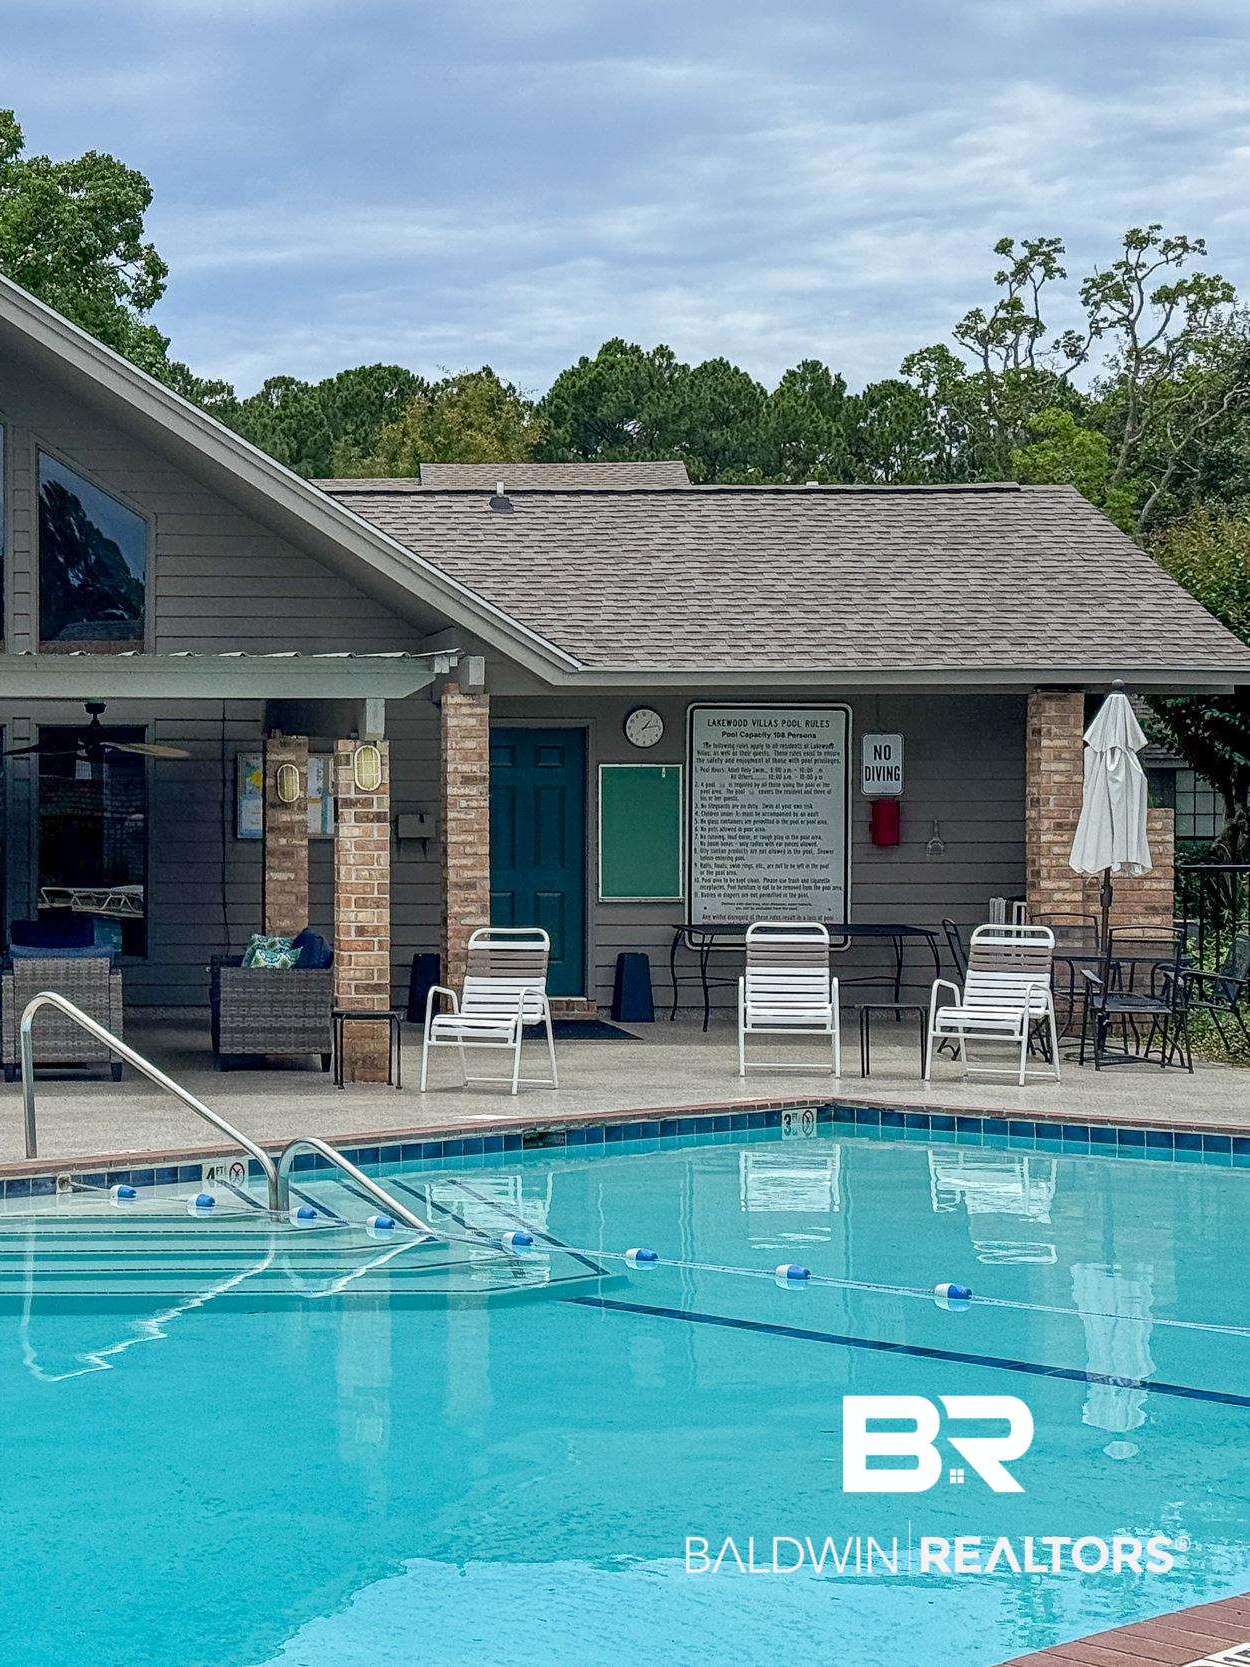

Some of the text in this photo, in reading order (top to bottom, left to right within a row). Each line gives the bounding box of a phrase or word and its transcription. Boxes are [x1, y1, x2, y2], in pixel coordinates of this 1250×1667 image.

[708, 719, 830, 727] LAKEWOOD VILLAS POOL RULES
[740, 731, 770, 739] Capacity
[873, 745, 891, 760] NO
[865, 765, 900, 781] DIVING
[216, 1166, 223, 1175] FT
